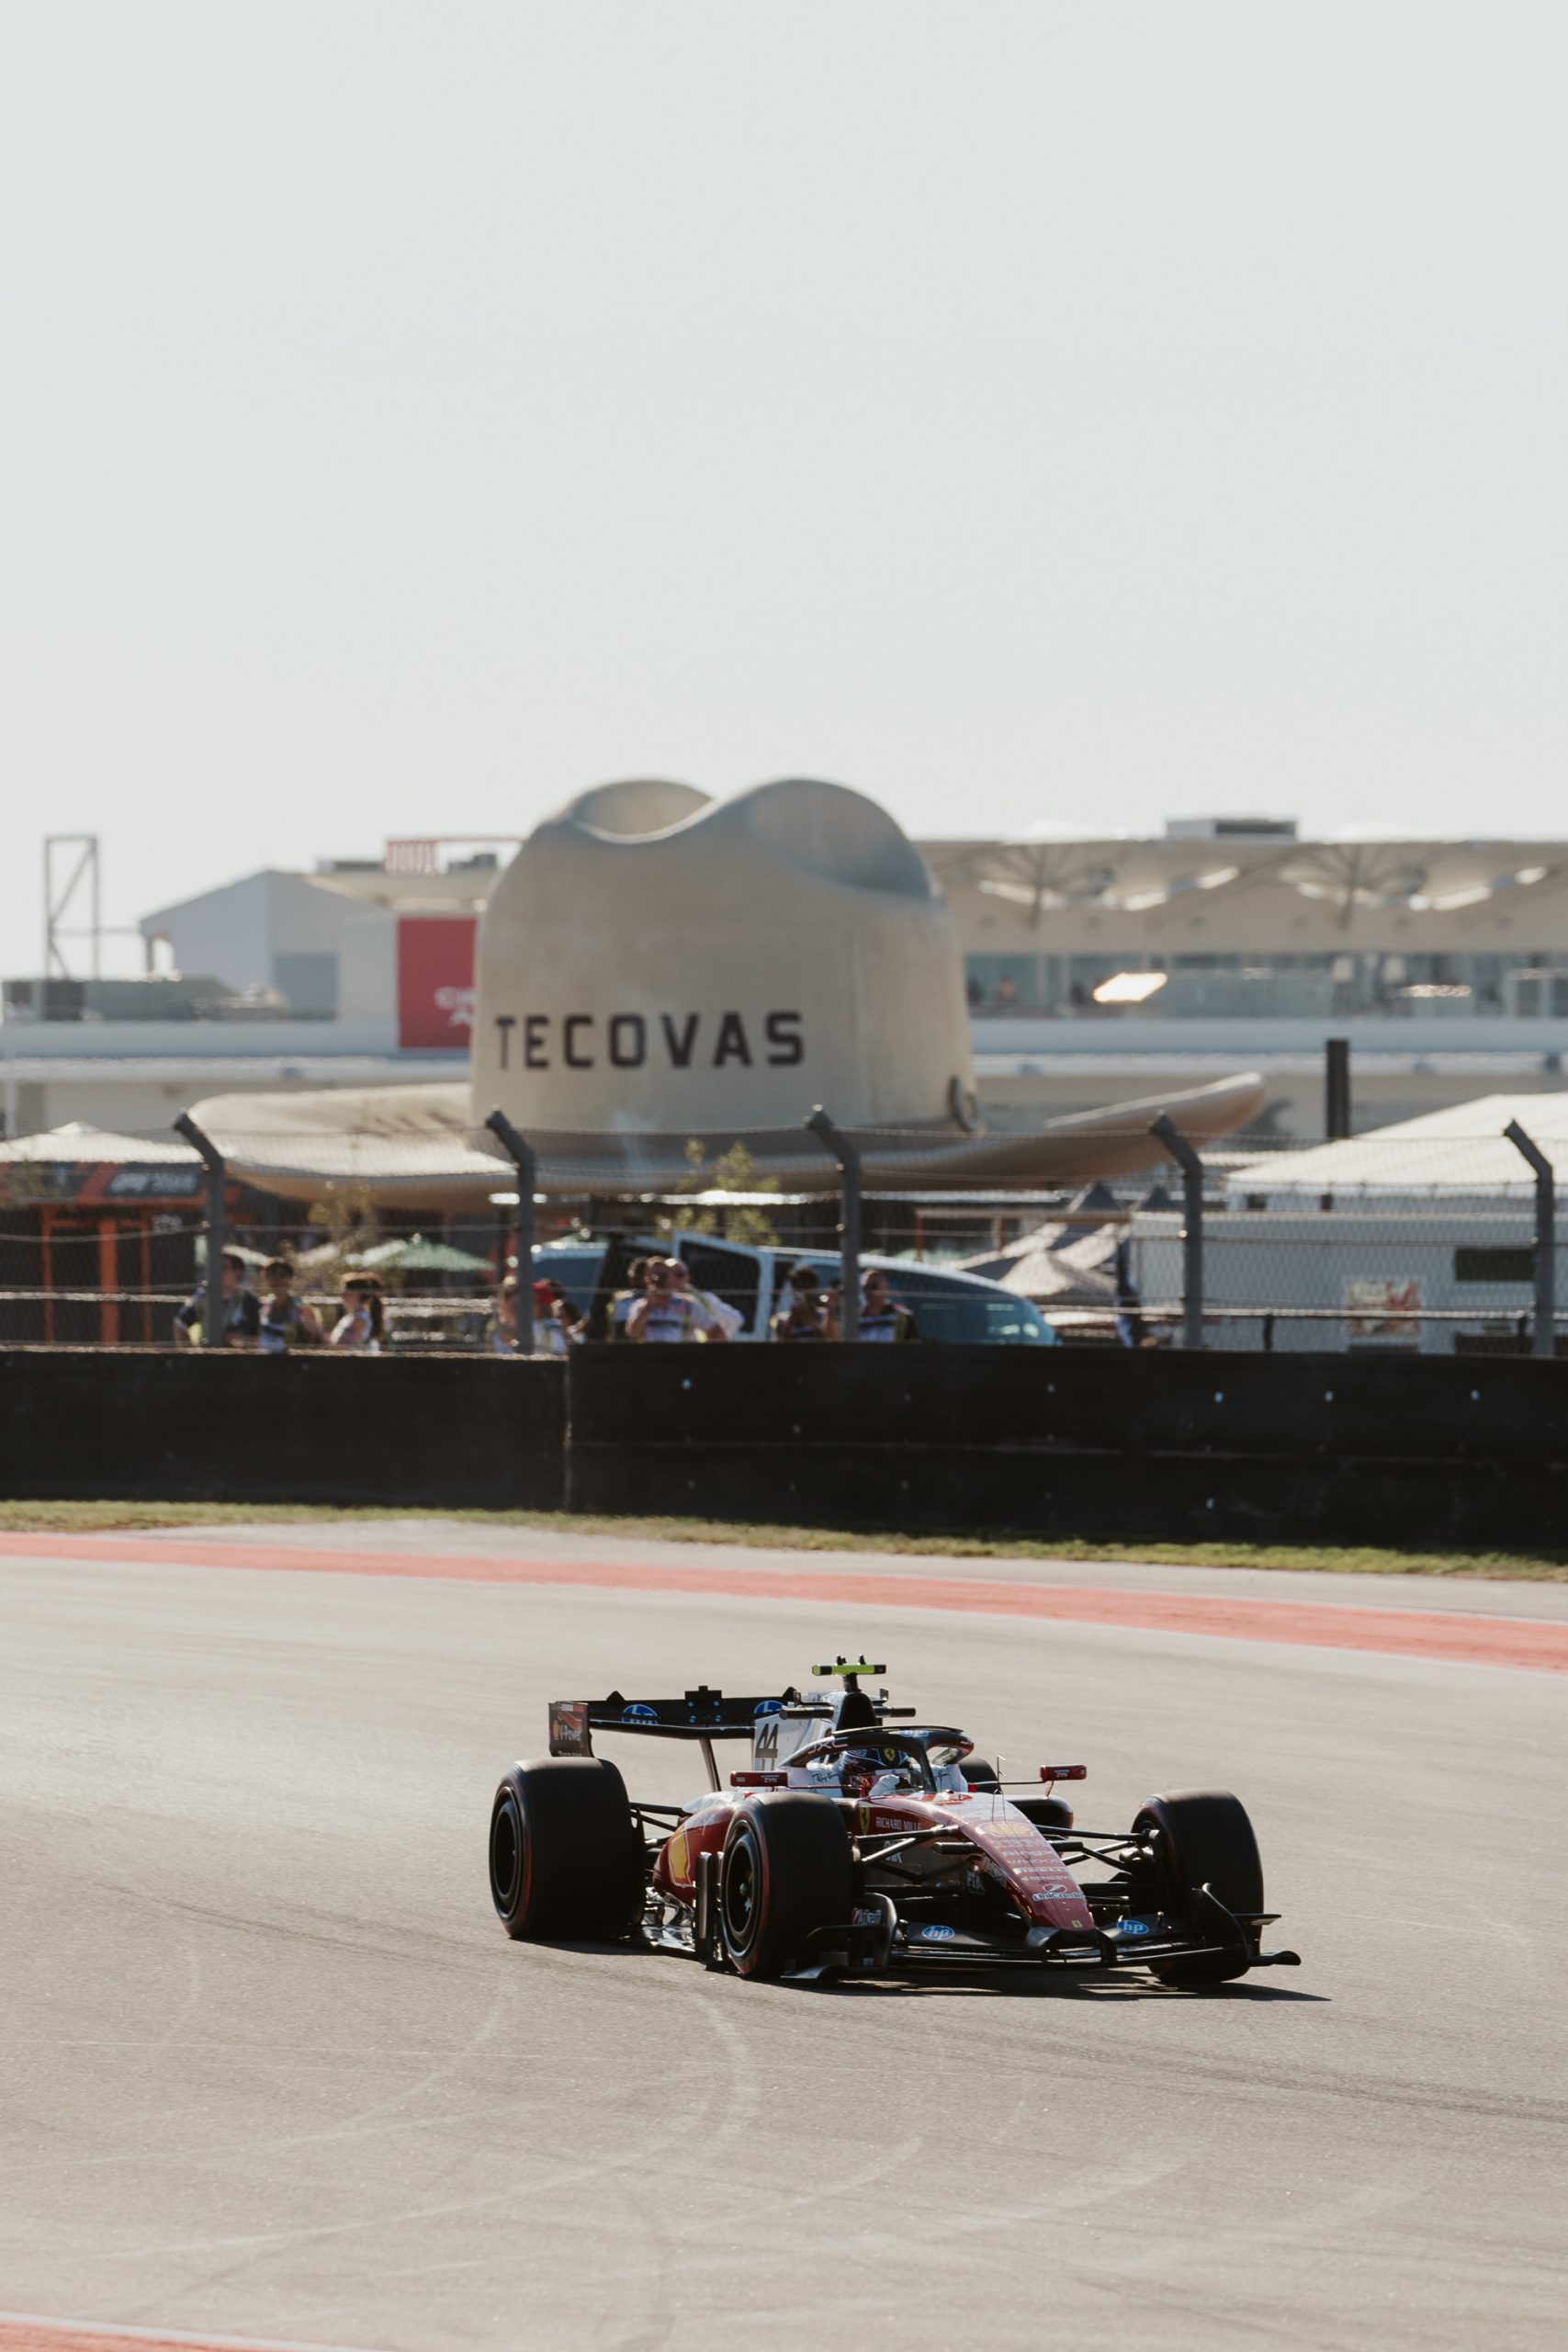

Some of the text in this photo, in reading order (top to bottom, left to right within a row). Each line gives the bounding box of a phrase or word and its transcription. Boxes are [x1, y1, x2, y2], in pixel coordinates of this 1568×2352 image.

[495, 1012, 805, 1070] TECOVAS
[755, 1724, 779, 1770] 44
[875, 1816, 922, 1831] RICHARD MILLE
[927, 1926, 950, 1940] hp
[1121, 1919, 1145, 1935] hp
